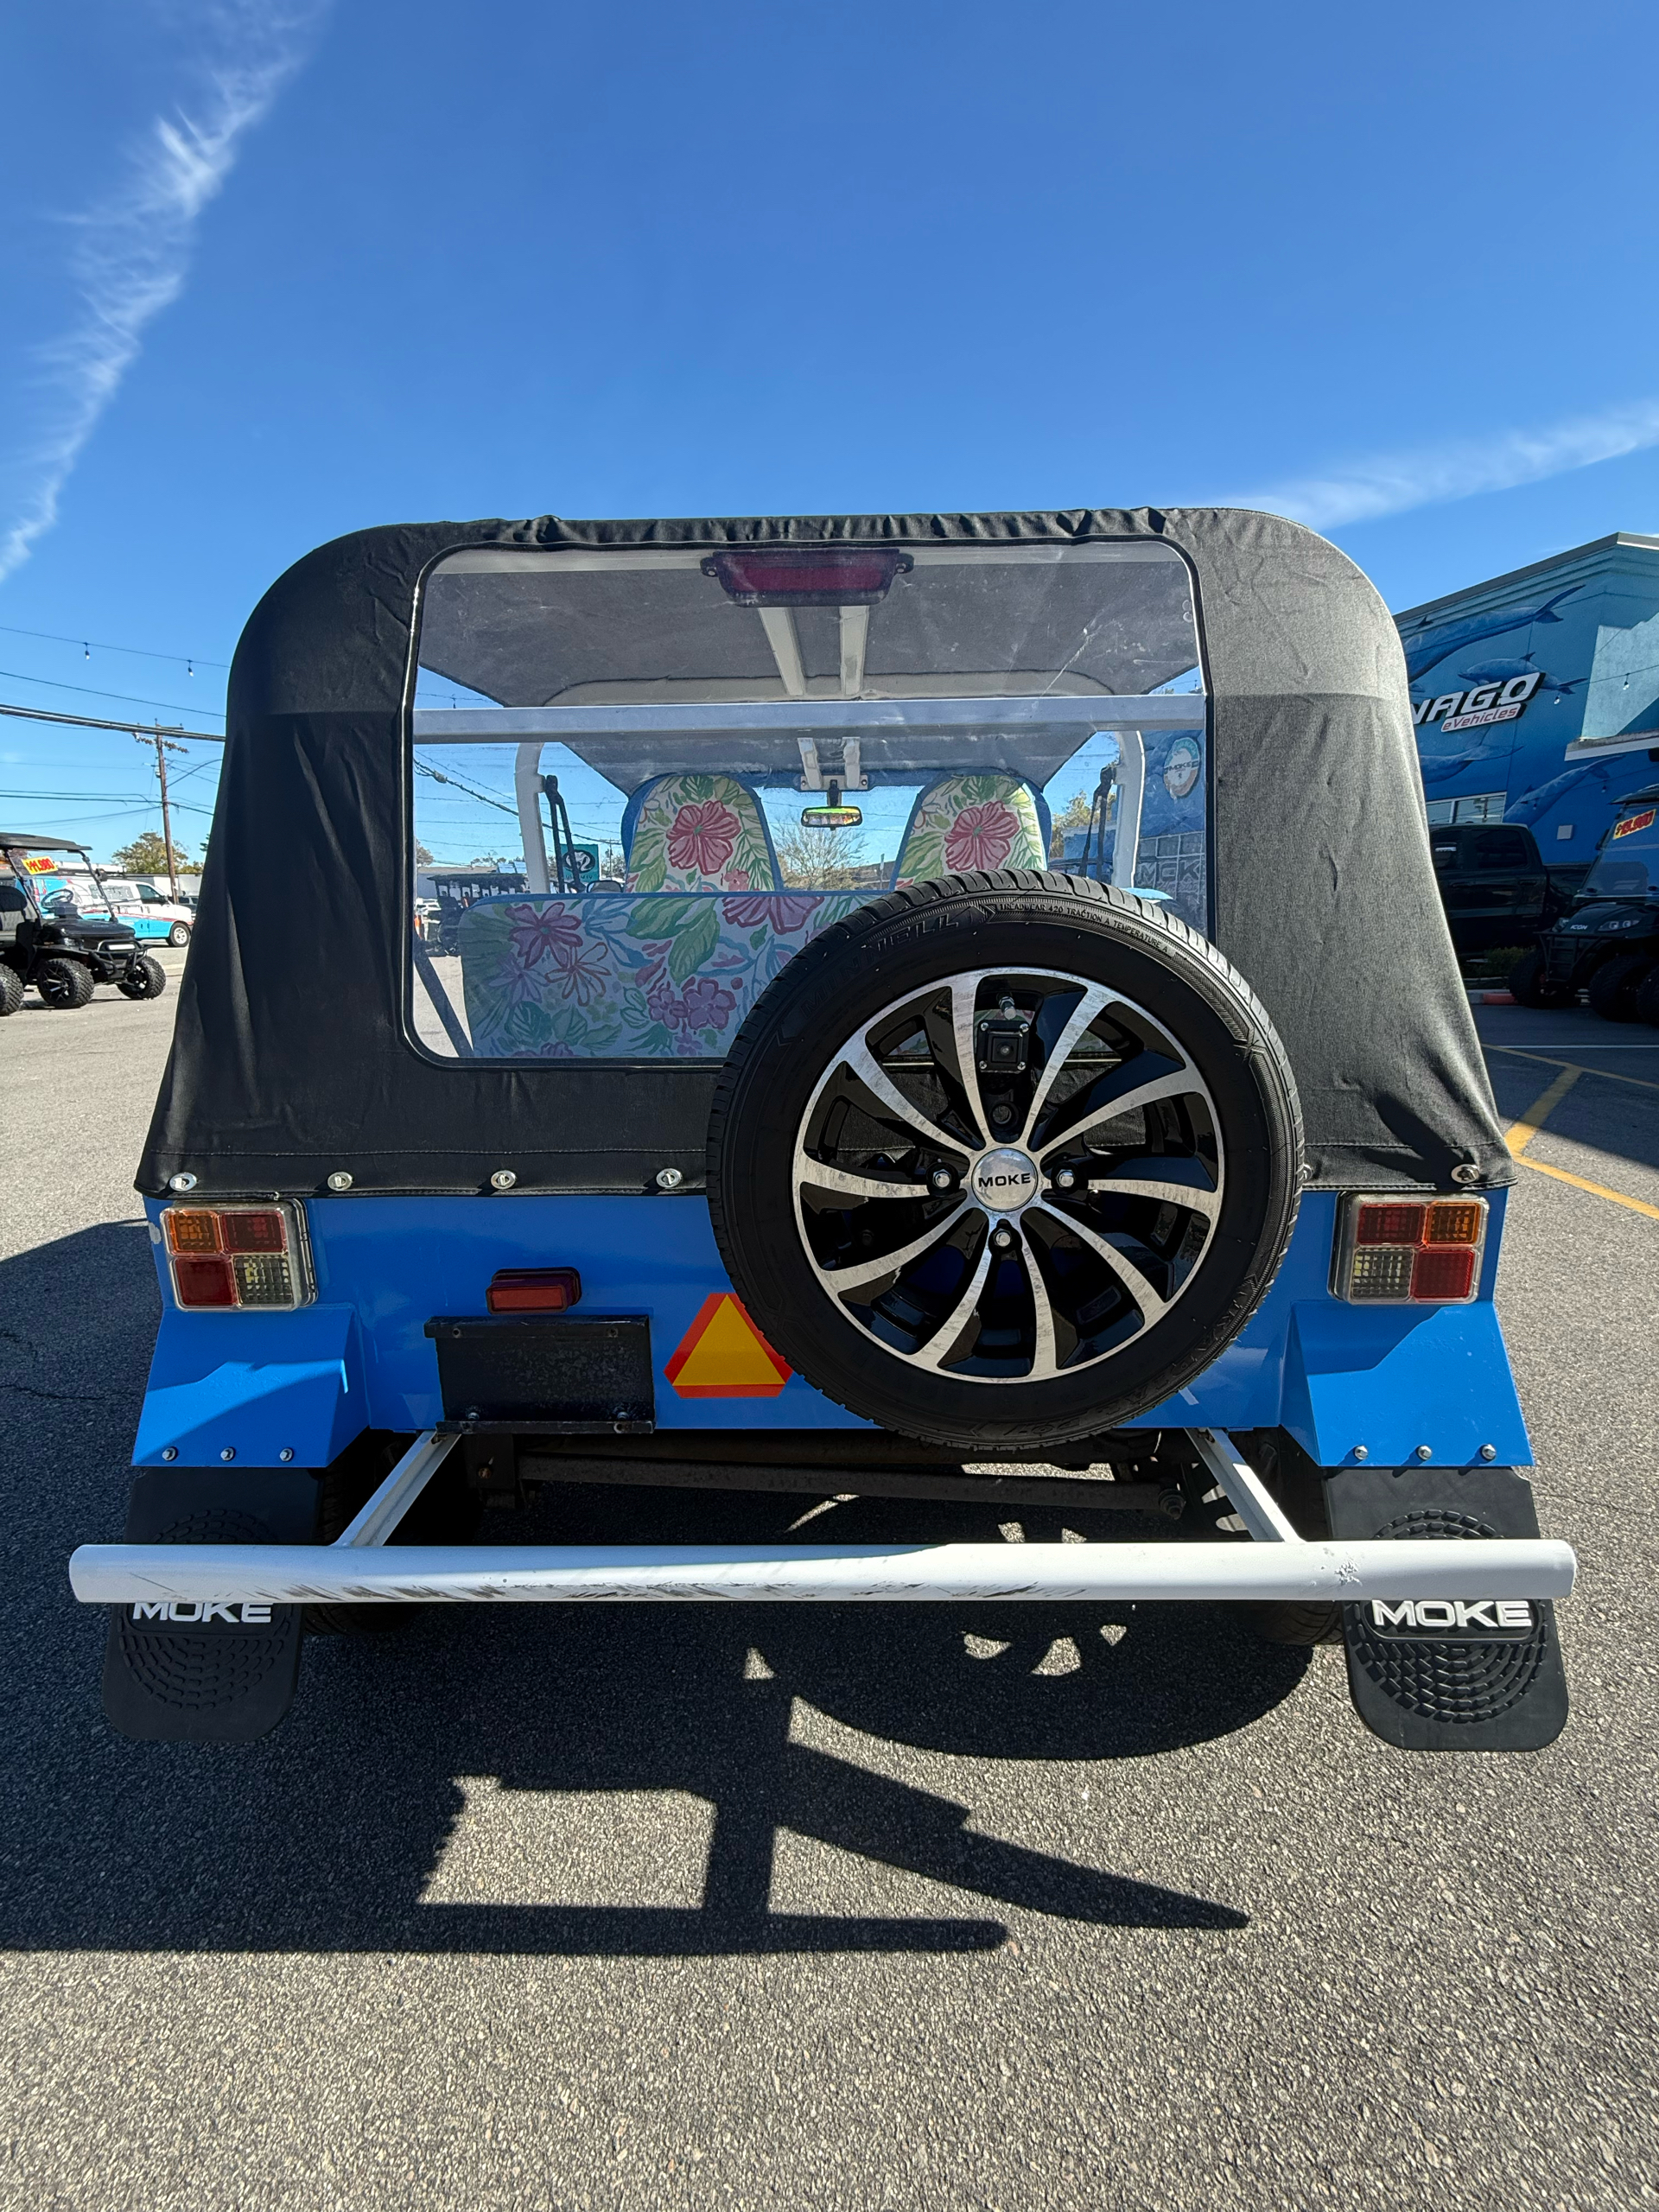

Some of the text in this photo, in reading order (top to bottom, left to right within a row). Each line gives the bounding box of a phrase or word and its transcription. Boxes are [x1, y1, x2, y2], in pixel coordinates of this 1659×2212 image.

[1443, 706, 1518, 731] eVehicles
[1000, 903, 1046, 912] TREADWEAR
[1048, 905, 1064, 913] 420
[1067, 907, 1102, 922] TRACTION
[1113, 920, 1161, 949] TEMPERATURE
[798, 913, 959, 1020] MINNELL
[978, 1173, 1031, 1187] MOKE
[133, 1603, 273, 1624] MOKE
[1371, 1600, 1532, 1628] MOKE
